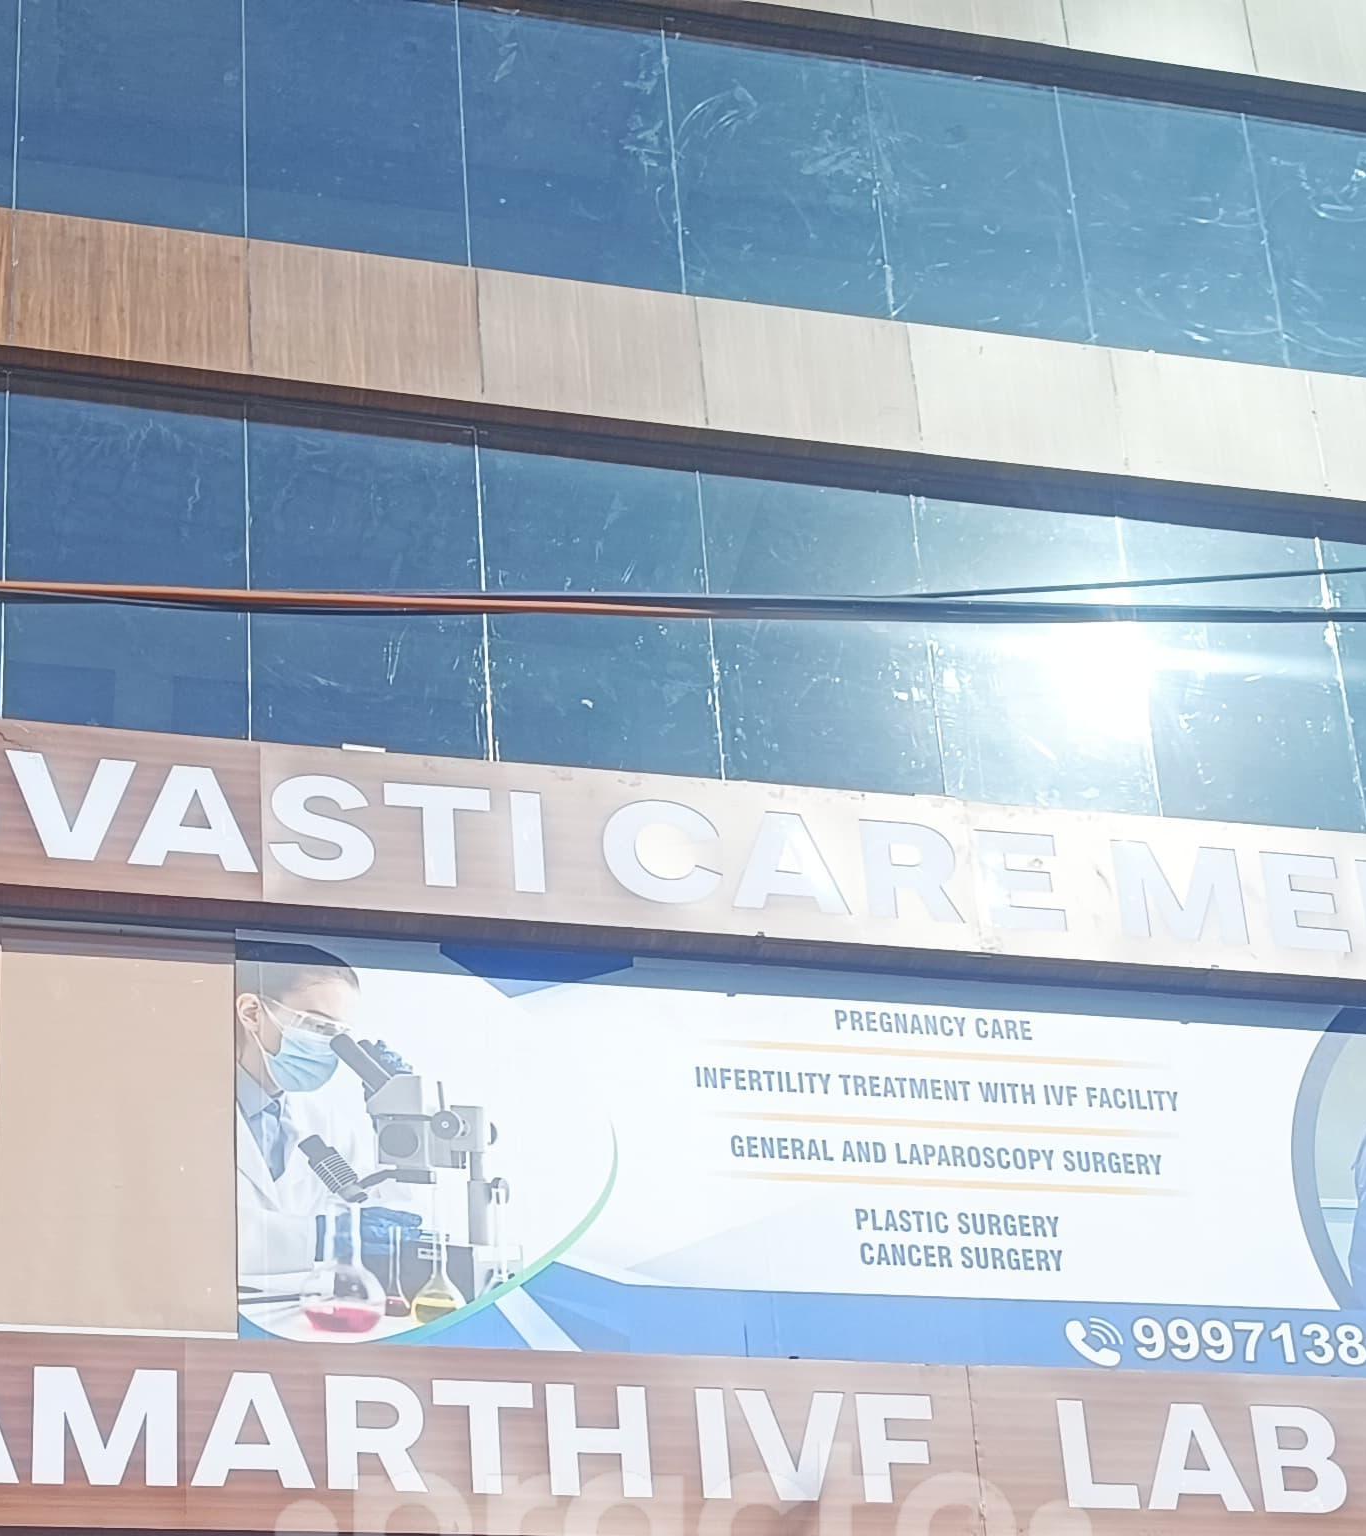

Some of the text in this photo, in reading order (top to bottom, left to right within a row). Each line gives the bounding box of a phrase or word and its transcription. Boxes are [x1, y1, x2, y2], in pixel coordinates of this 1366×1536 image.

[602, 799, 1068, 927] CARE
[834, 1009, 1033, 1041] PREGNANCY CARE
[694, 1065, 1179, 1112] INFERTILITY TREATMENT WITH IVF FACILITY
[729, 1134, 1163, 1176] GENERAL AND LAPAROSCOPY SURGERY
[854, 1208, 1060, 1239] PLASTIC SURGERY
[859, 1242, 1064, 1273] CANCER SURGERY
[694, 1387, 935, 1503] IVF
[1054, 1397, 1347, 1518] LAB
